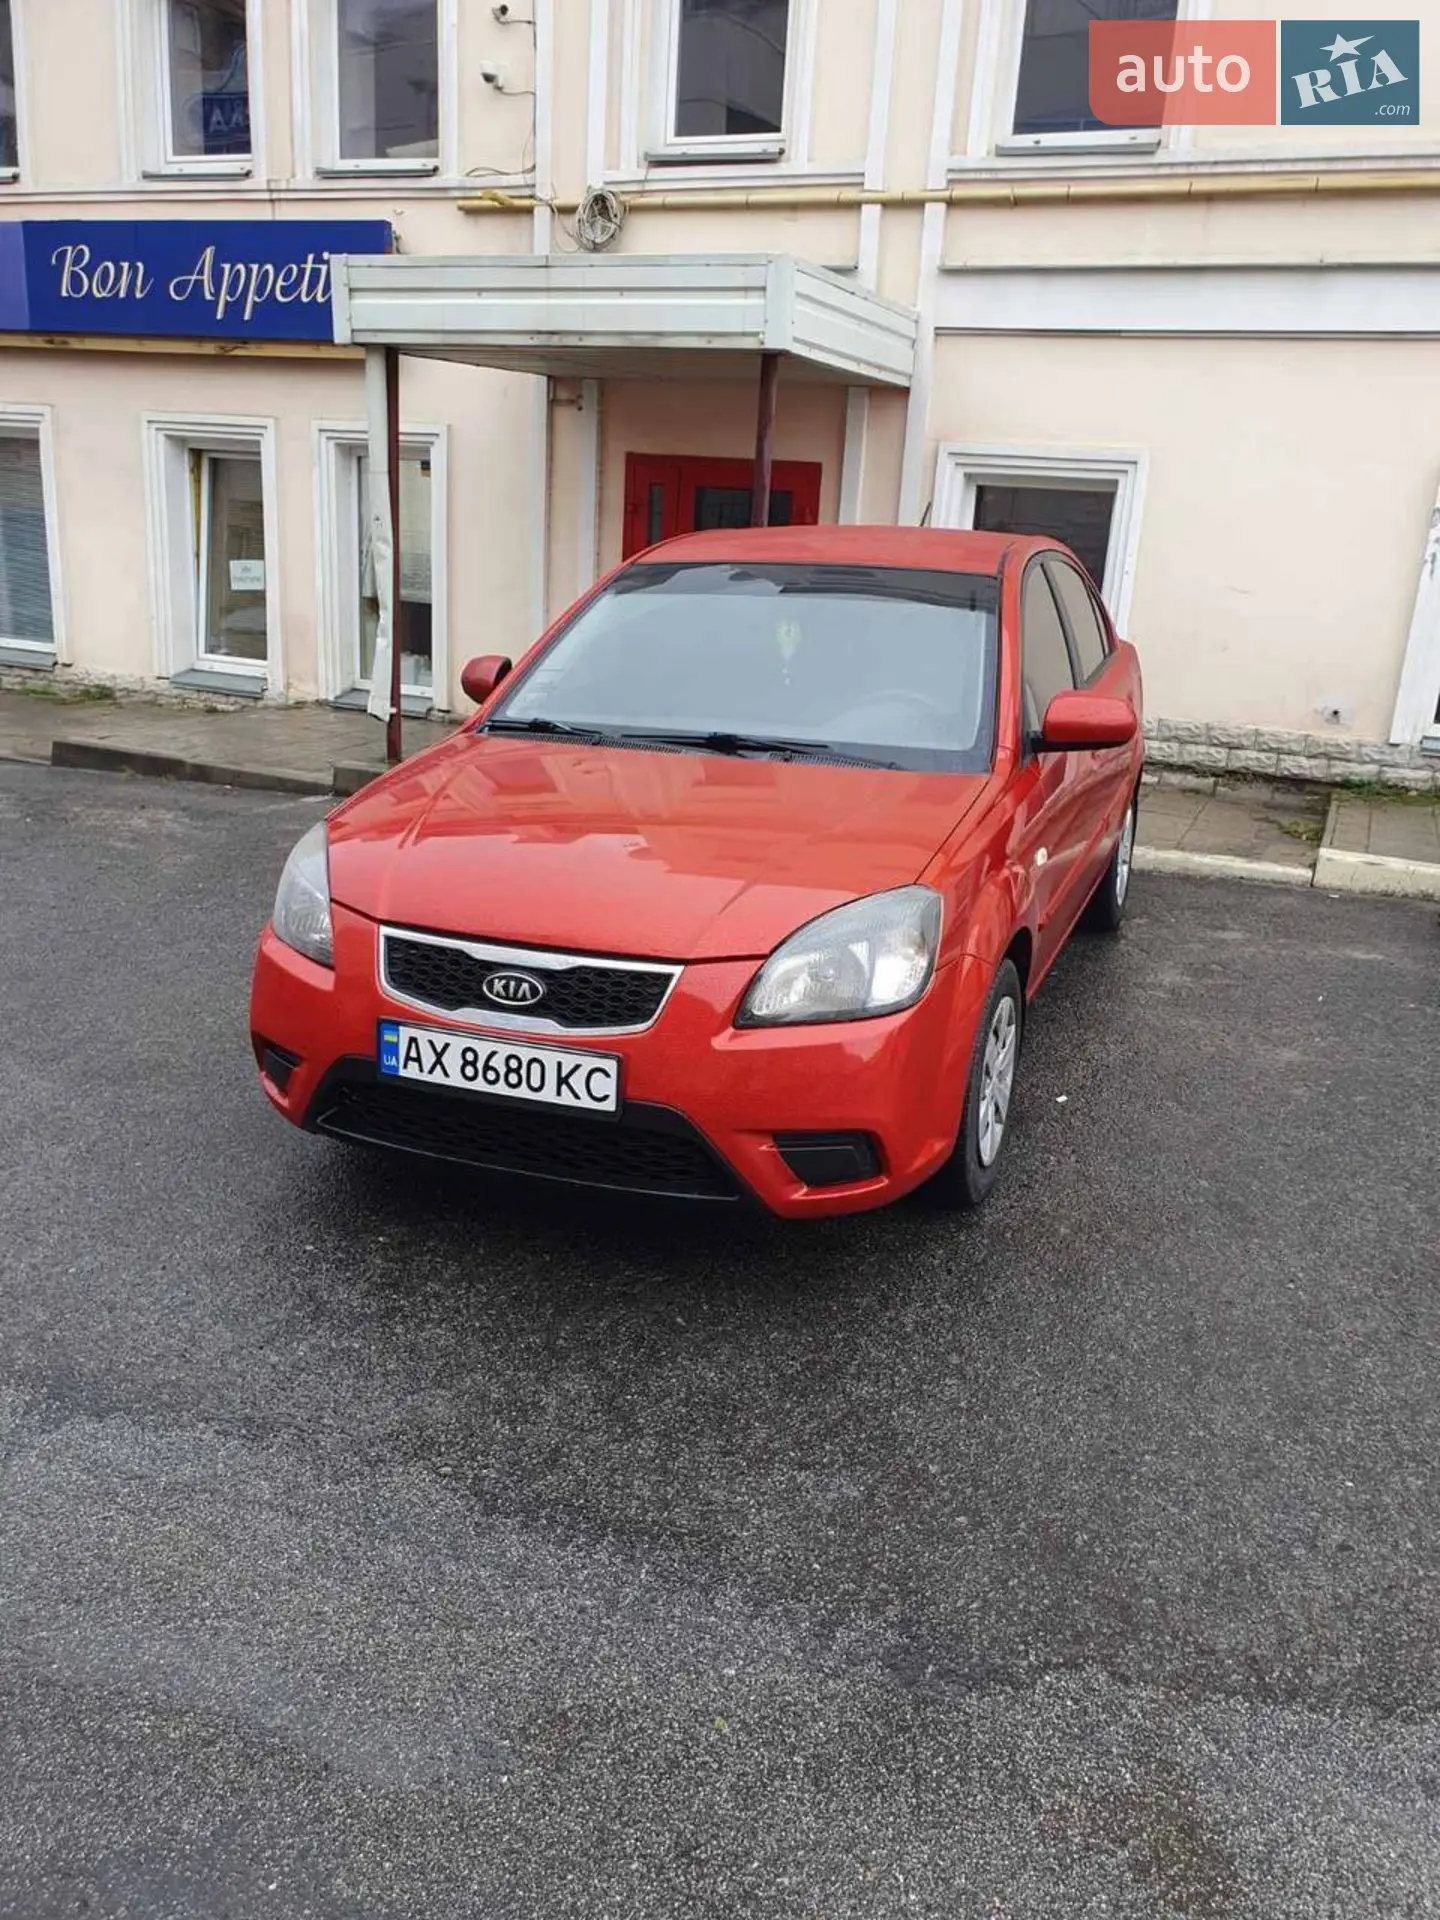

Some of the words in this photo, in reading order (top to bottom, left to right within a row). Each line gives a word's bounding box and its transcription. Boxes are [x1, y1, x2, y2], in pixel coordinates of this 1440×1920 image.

[51, 244, 154, 298] Bon
[492, 978, 532, 1000] KIA
[383, 1053, 398, 1067] UA
[402, 1036, 450, 1078] AX
[460, 1046, 546, 1093] 8680
[555, 1060, 612, 1103] KC
